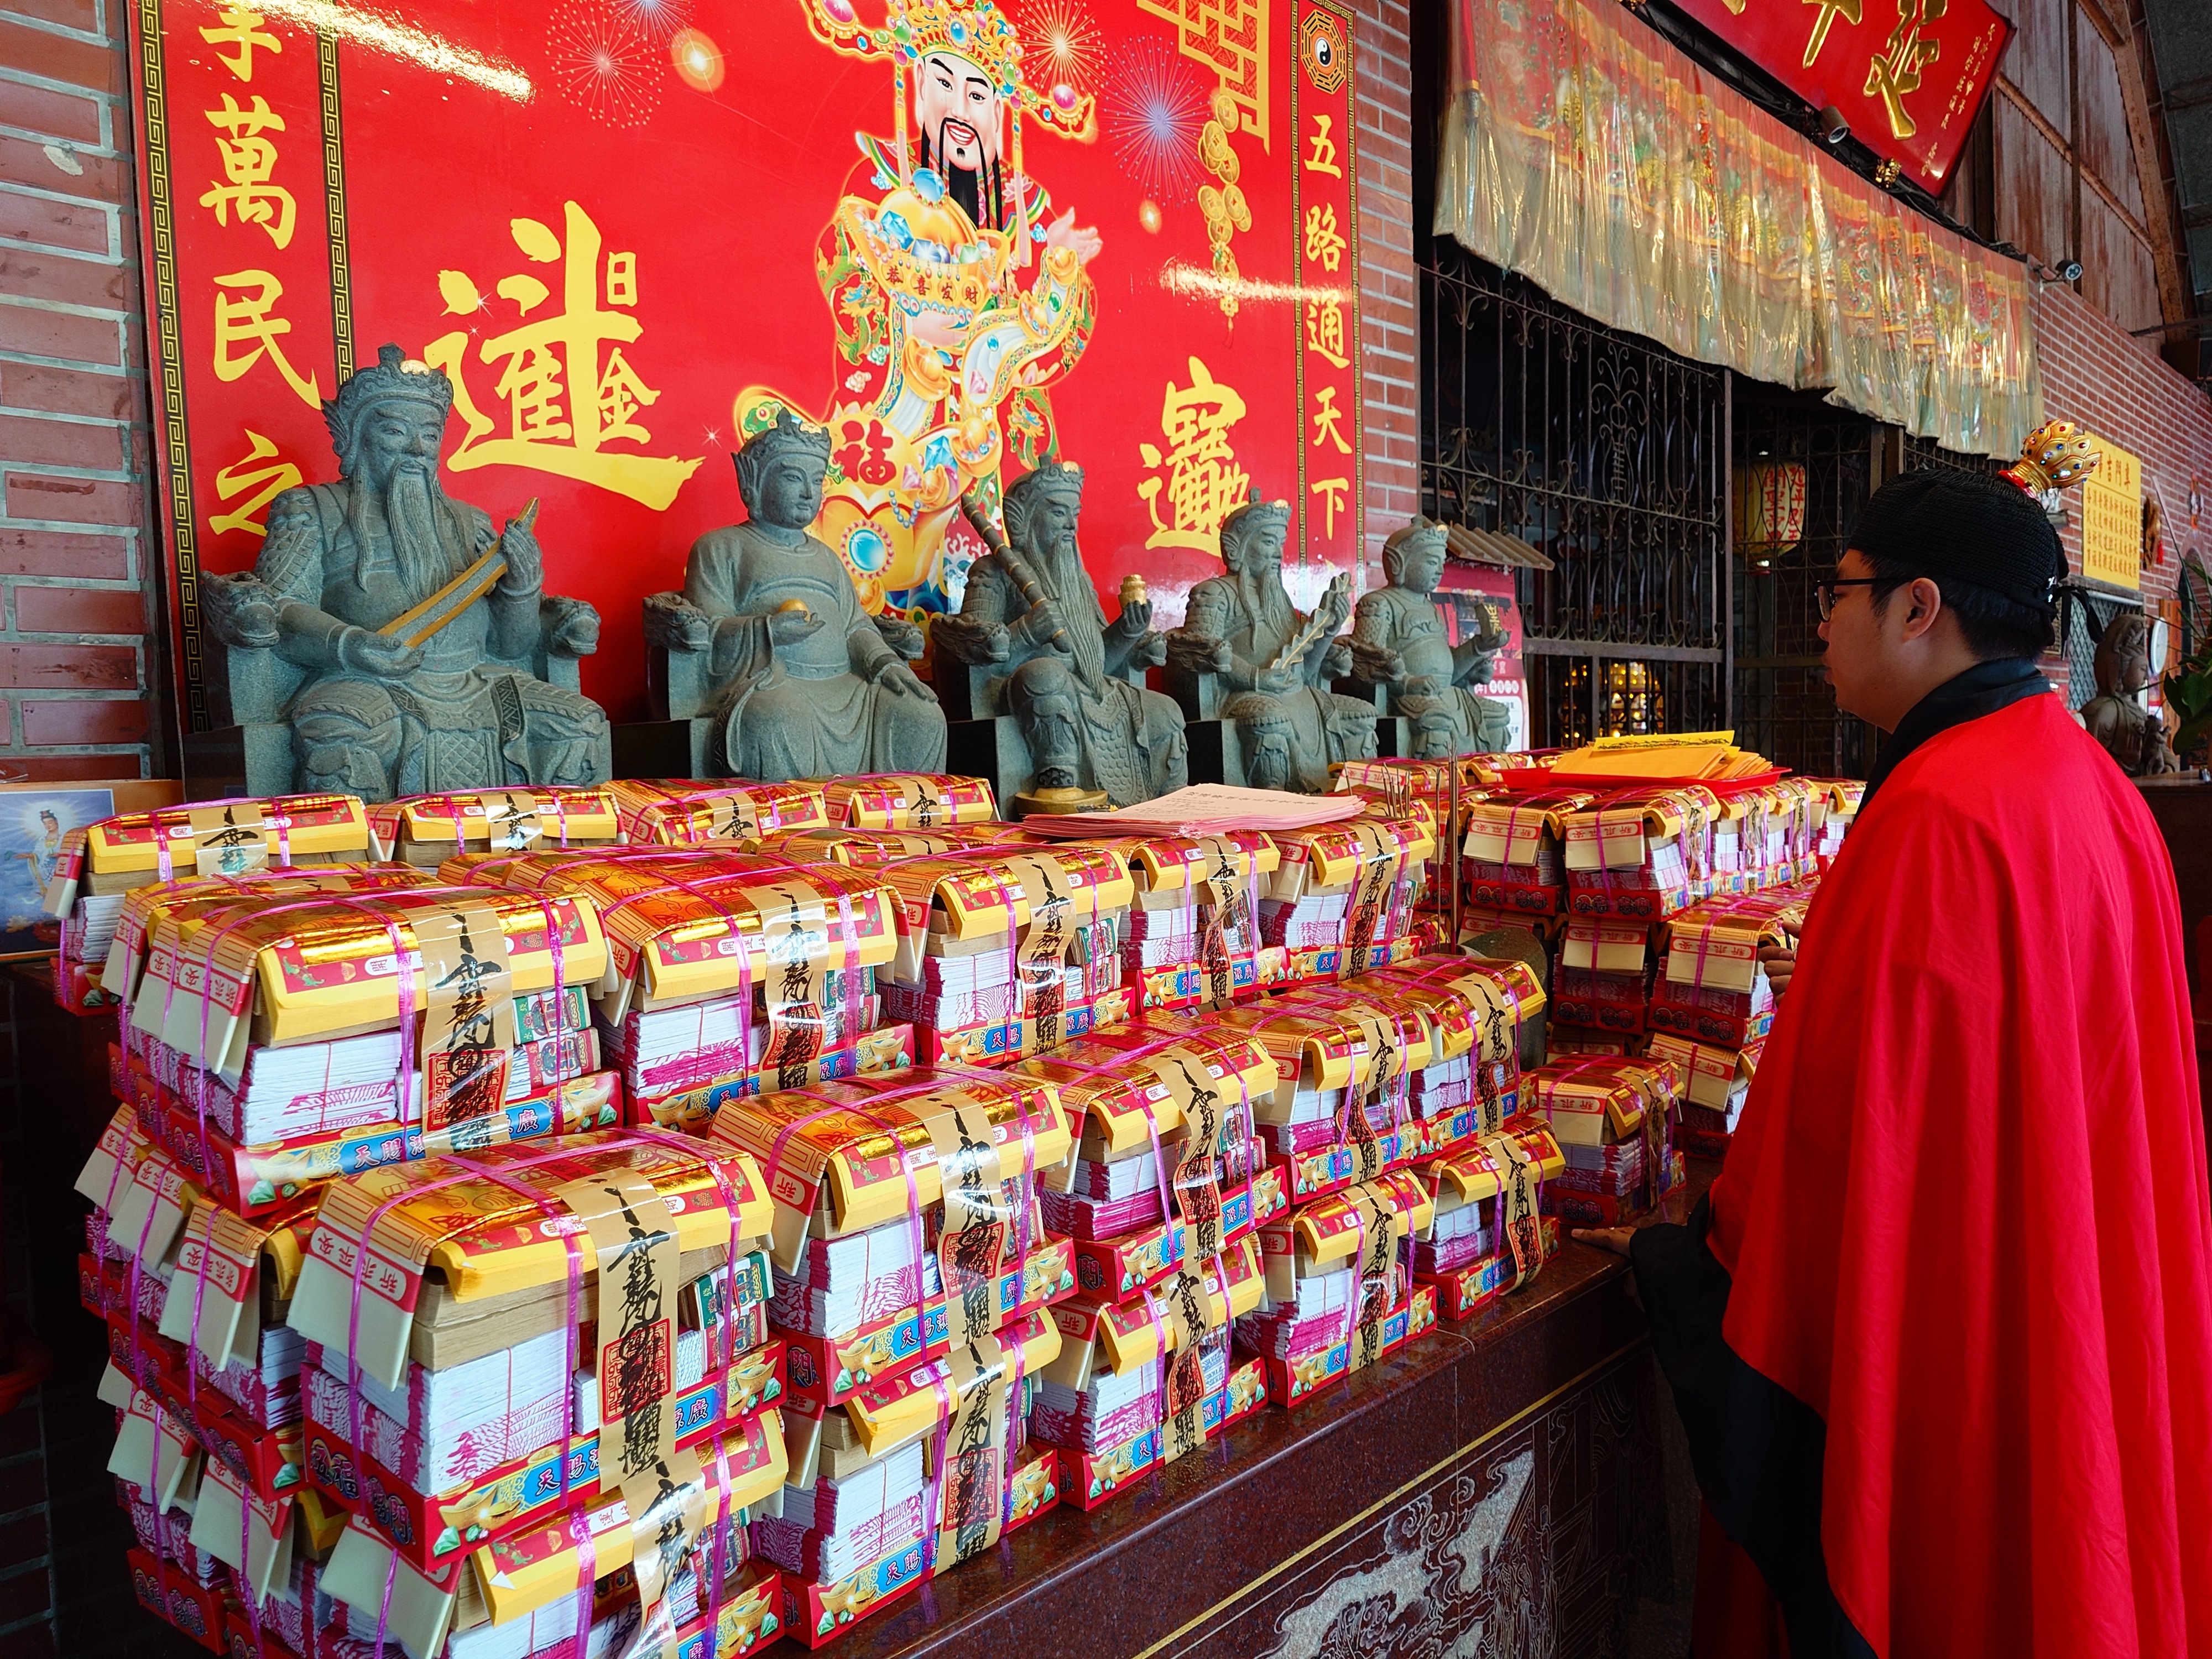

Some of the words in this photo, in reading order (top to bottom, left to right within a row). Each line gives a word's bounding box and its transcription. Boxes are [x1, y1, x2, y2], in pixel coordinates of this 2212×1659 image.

[885, 265, 978, 304] 恭喜发财
[1304, 114, 1353, 541] 五路通天下
[831, 419, 896, 486] 福
[317, 1232, 398, 1293] 祈求平安
